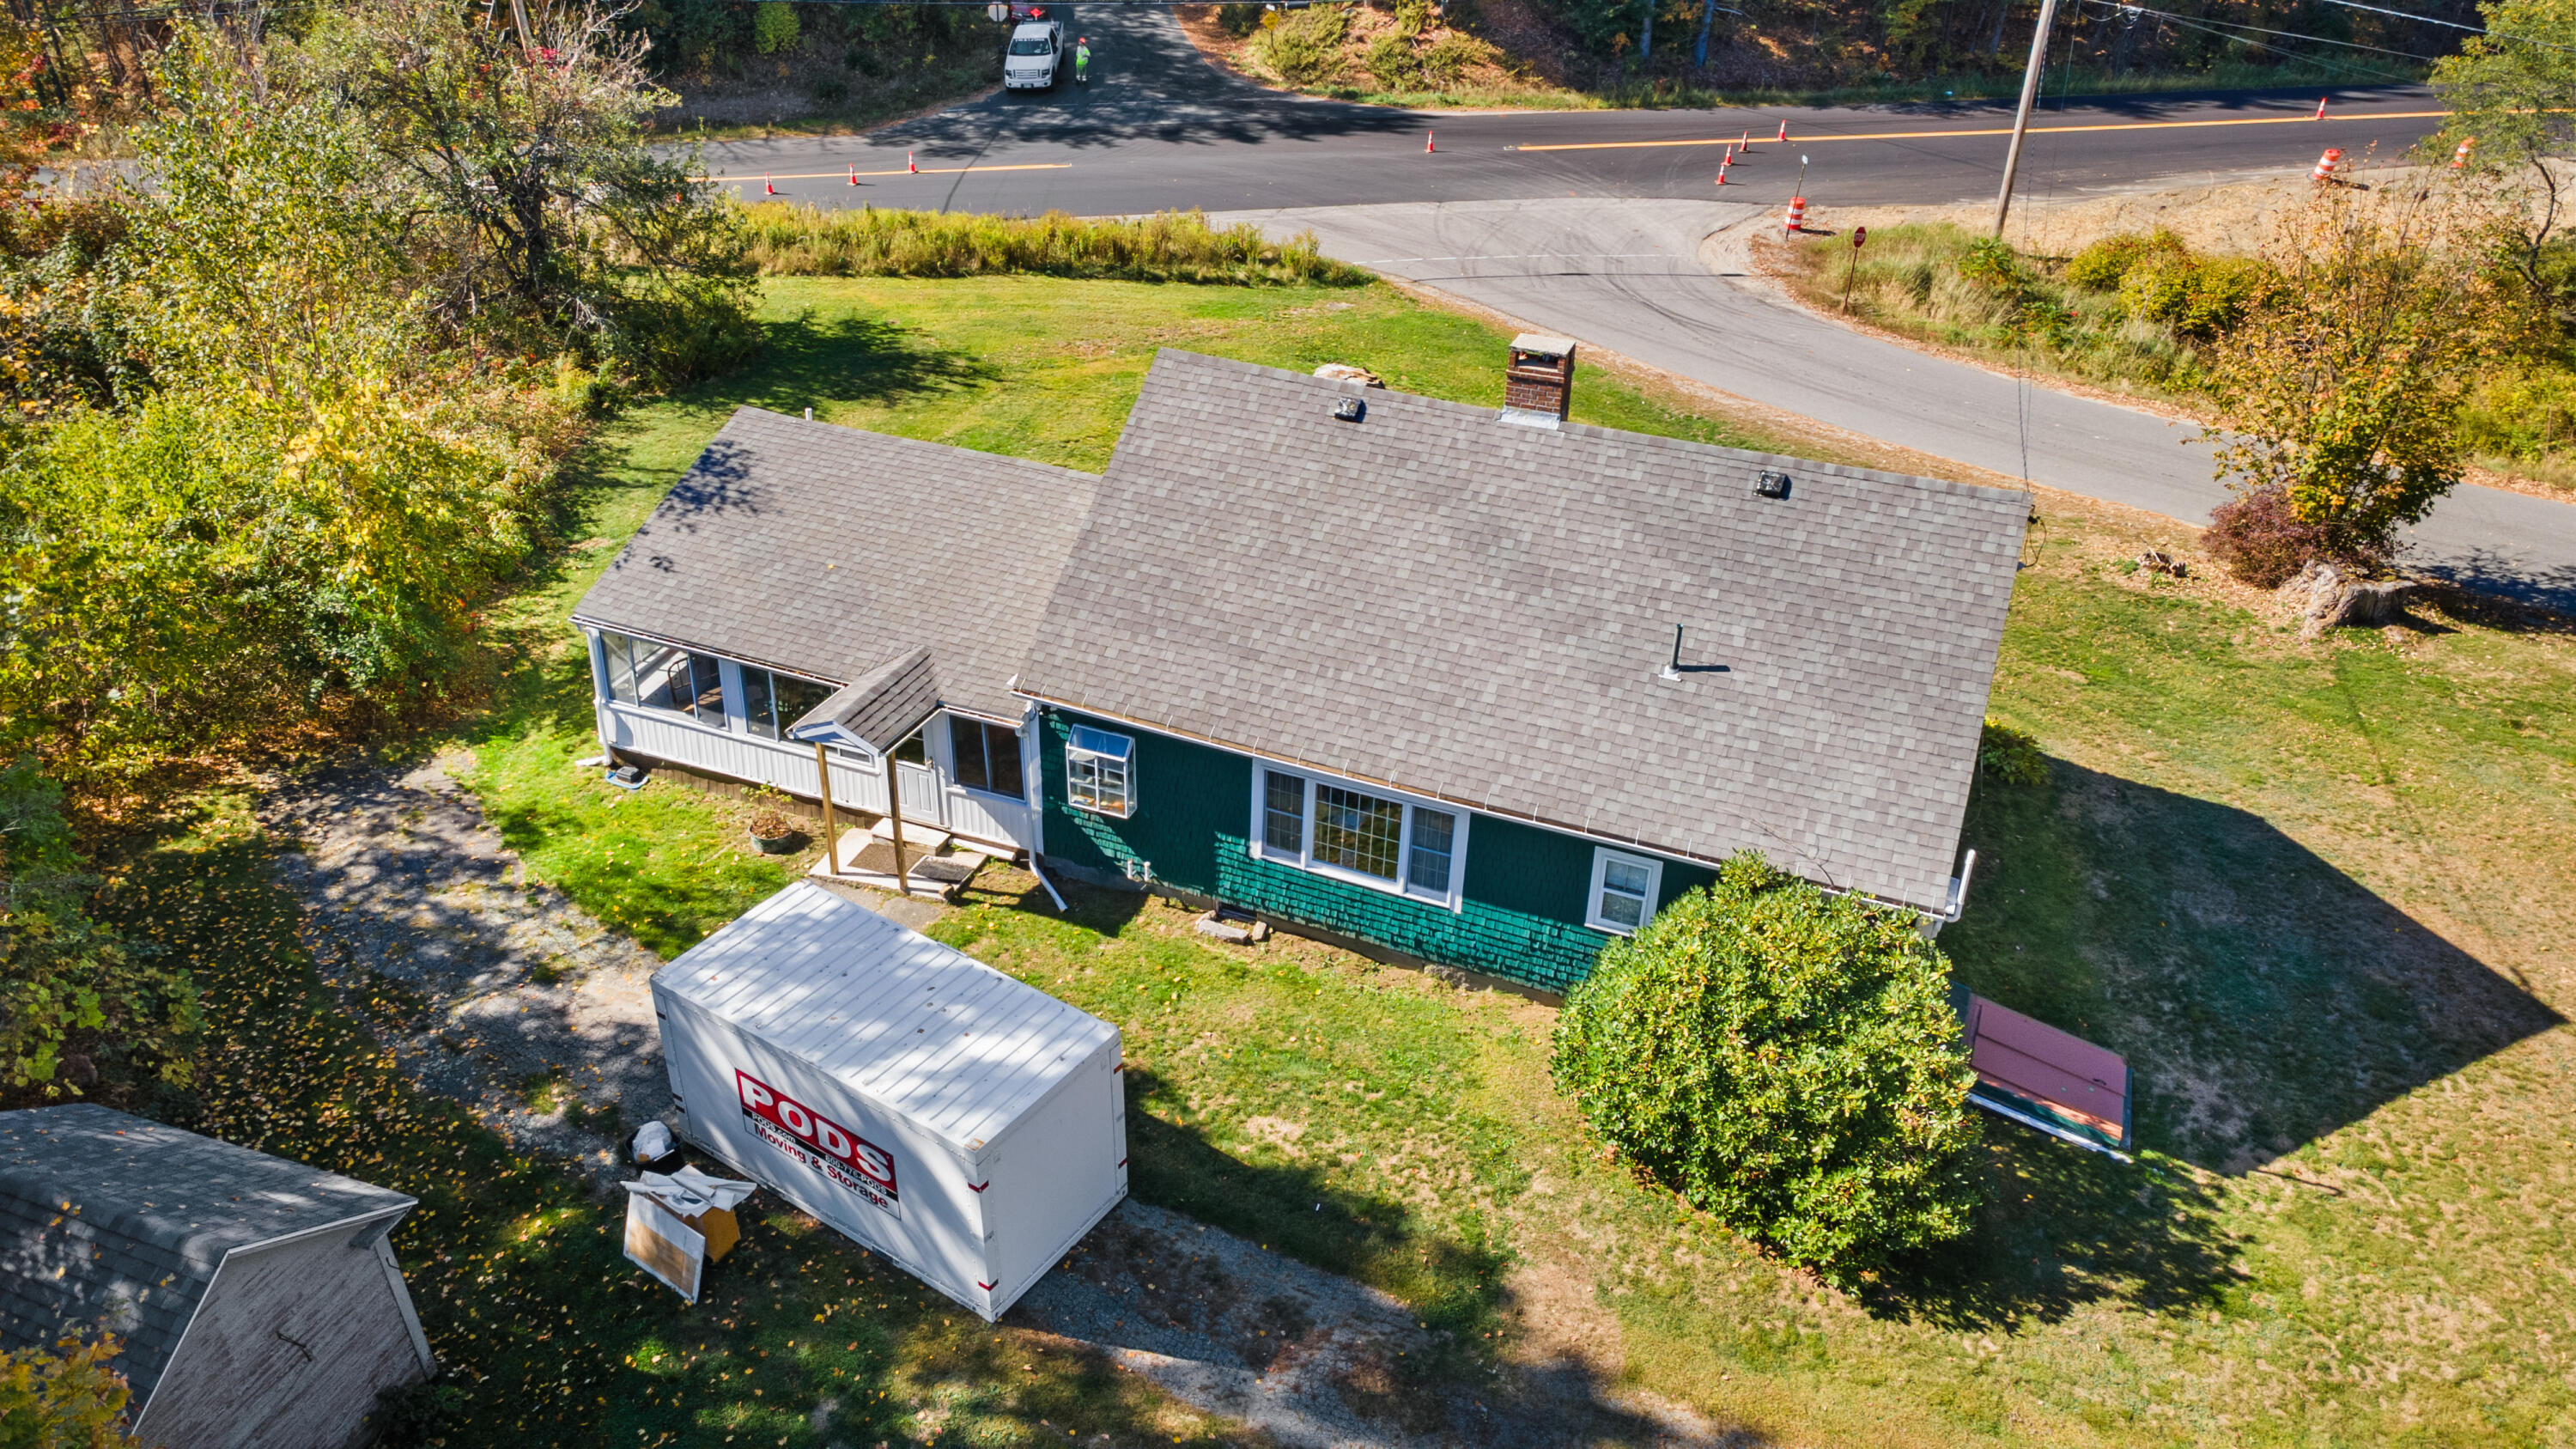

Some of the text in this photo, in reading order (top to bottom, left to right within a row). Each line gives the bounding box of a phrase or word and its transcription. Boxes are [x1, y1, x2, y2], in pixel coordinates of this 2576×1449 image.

[739, 1075, 891, 1182] PODS
[752, 1113, 796, 1143] PODS.com
[754, 1123, 889, 1209] Moving & Storage
